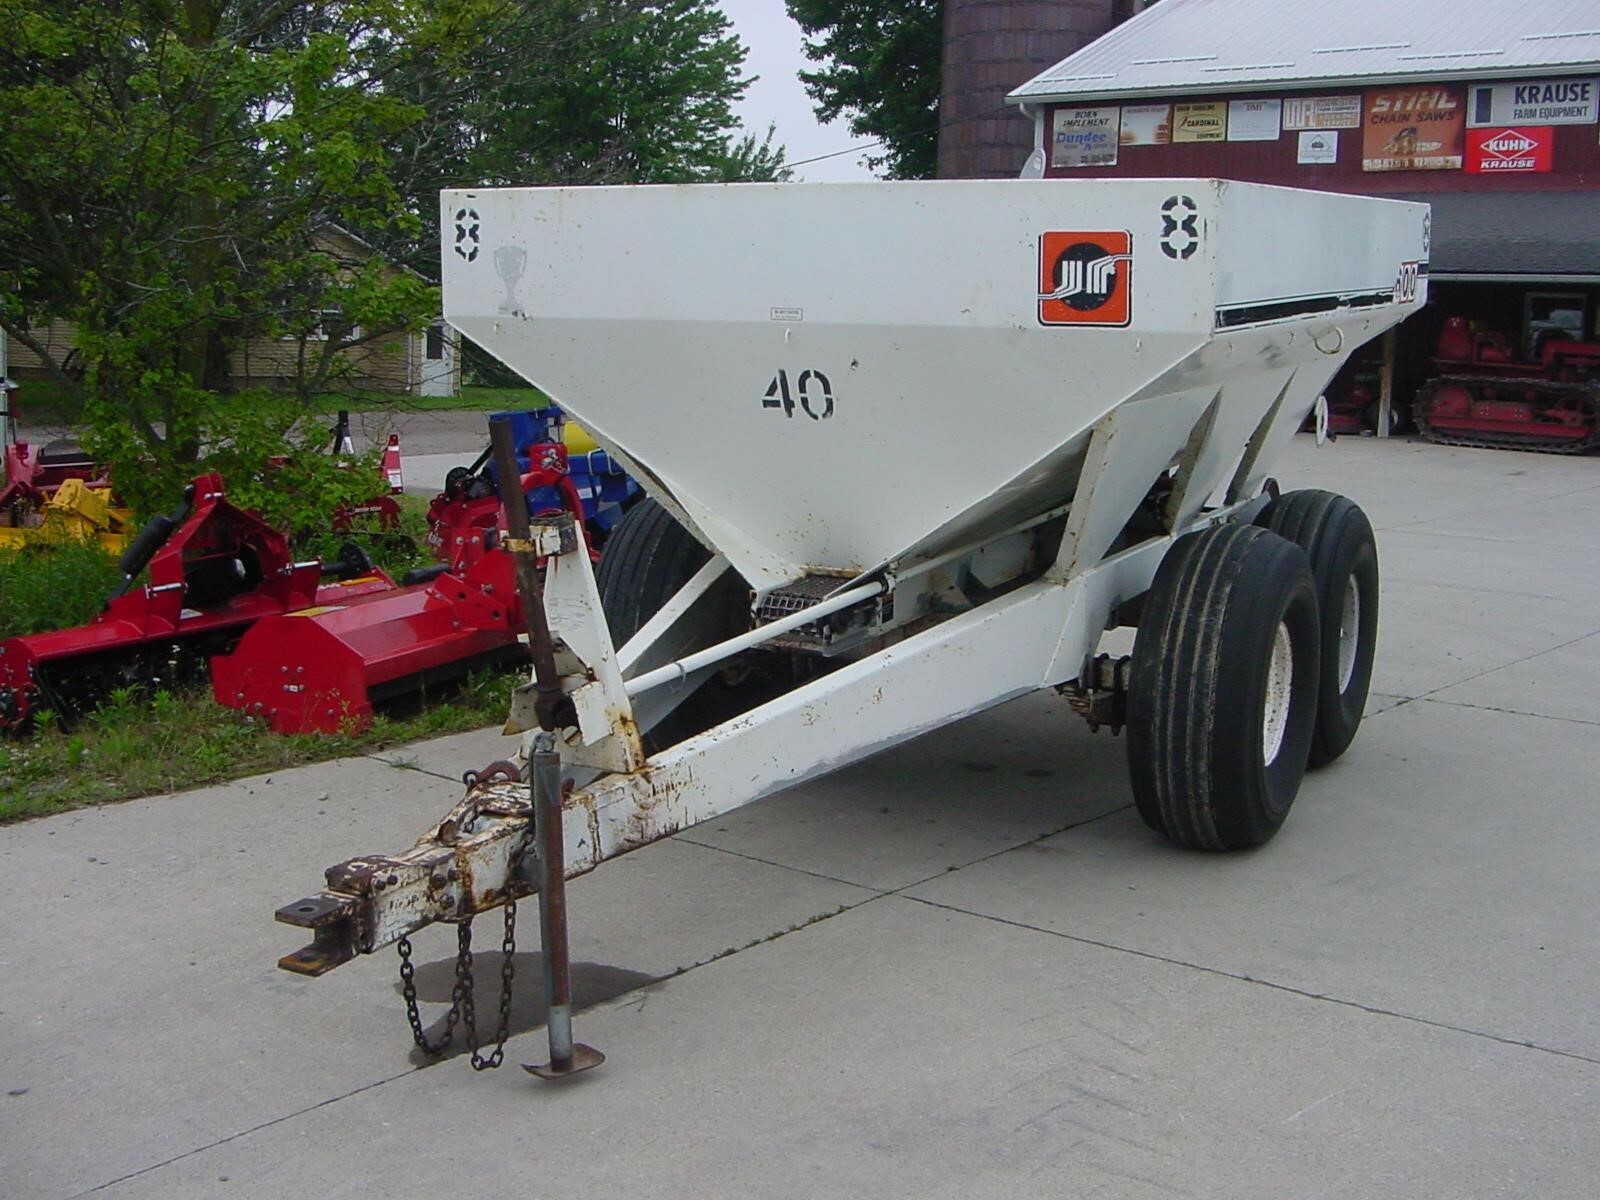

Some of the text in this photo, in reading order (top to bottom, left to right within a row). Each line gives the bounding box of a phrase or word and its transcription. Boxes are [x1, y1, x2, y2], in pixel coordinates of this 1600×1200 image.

[1514, 83, 1591, 105] KRAUSE
[1371, 91, 1457, 113] STIHL
[1074, 111, 1098, 119] BORN
[1371, 113, 1411, 125] CHAIN
[1416, 110, 1456, 123] SAWS
[1513, 106, 1589, 120] FARM EQUIPMENT
[1063, 118, 1110, 127] IMPLEMENT
[1187, 119, 1220, 127] CARDINAL
[1056, 132, 1107, 144] Dundee
[1489, 139, 1530, 151] KUHN
[1480, 160, 1536, 169] KRAUSE
[1160, 195, 1199, 260] 8
[454, 208, 480, 263] 8
[762, 369, 834, 421] 40
